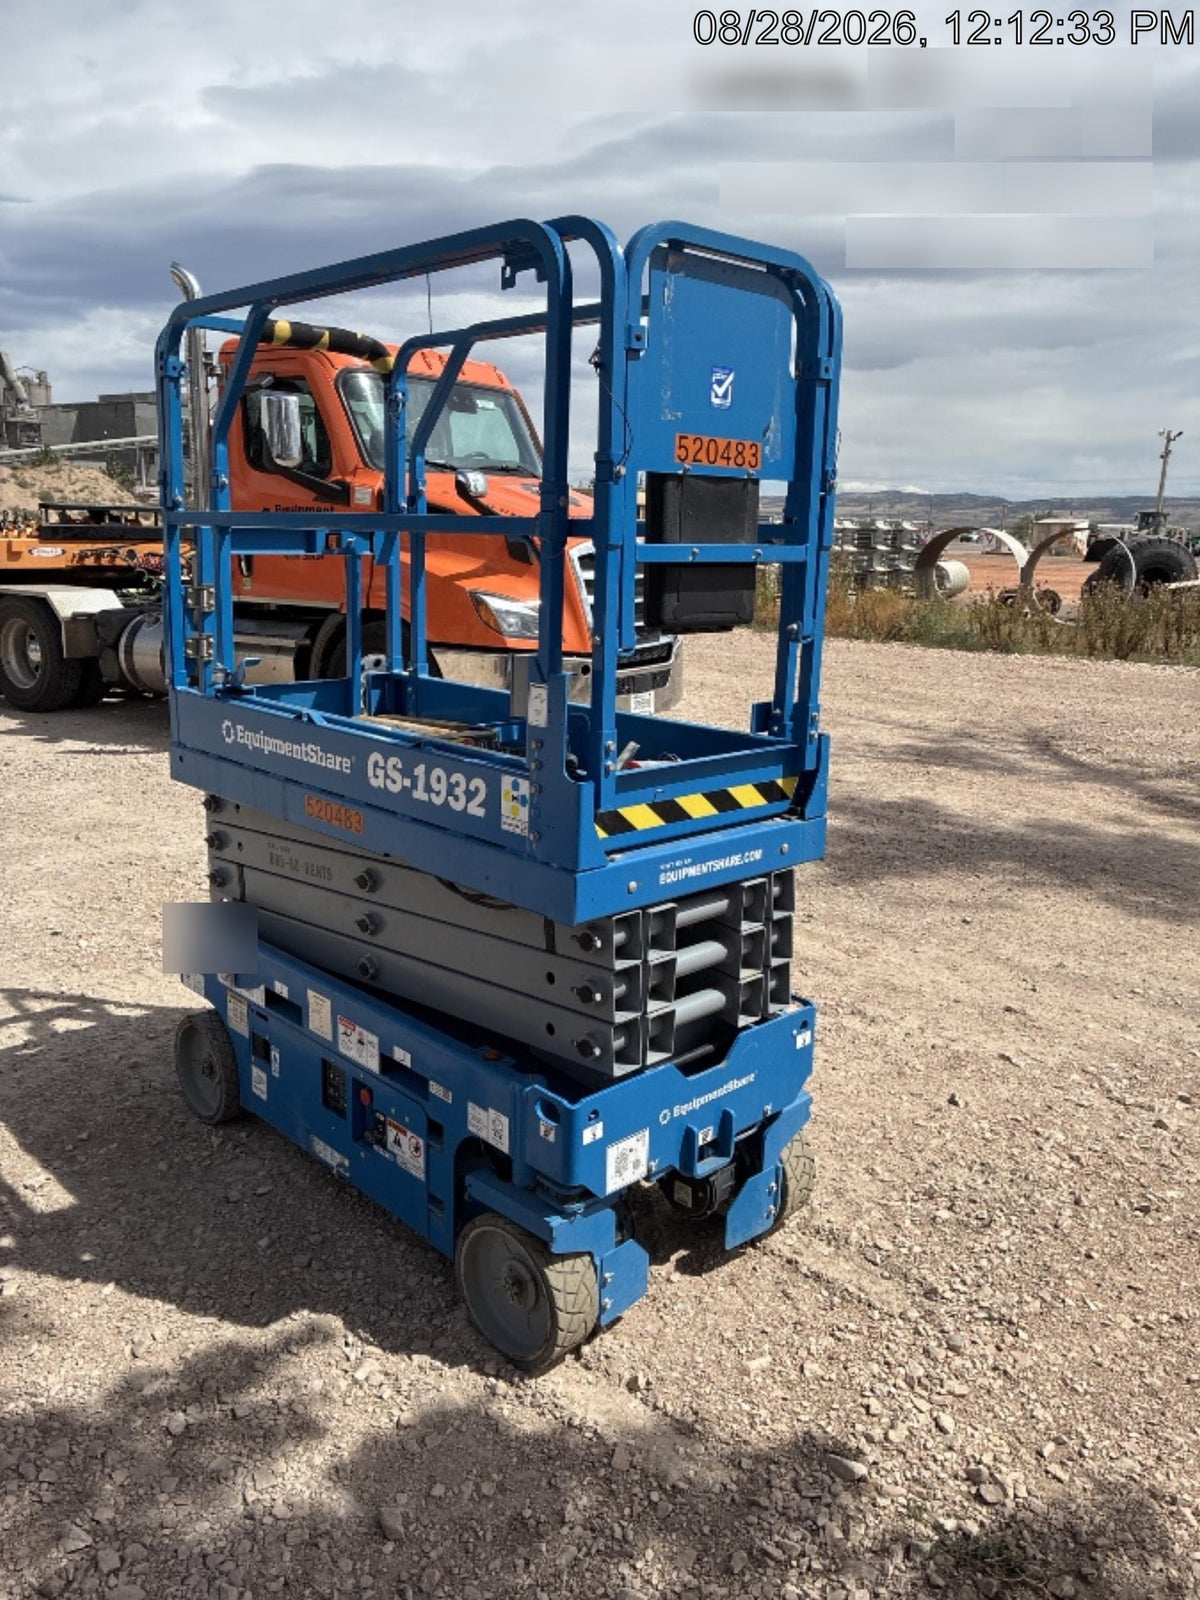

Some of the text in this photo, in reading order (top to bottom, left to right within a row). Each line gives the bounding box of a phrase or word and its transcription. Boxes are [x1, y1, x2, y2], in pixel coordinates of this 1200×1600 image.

[677, 435, 759, 468] 520483
[236, 724, 352, 774] EquipmentShare
[367, 751, 487, 818] GS-1932
[306, 795, 362, 833] 520483
[659, 848, 763, 885] EQUIPMENTSHARE.COM
[673, 1072, 755, 1117] EquipmentShare
